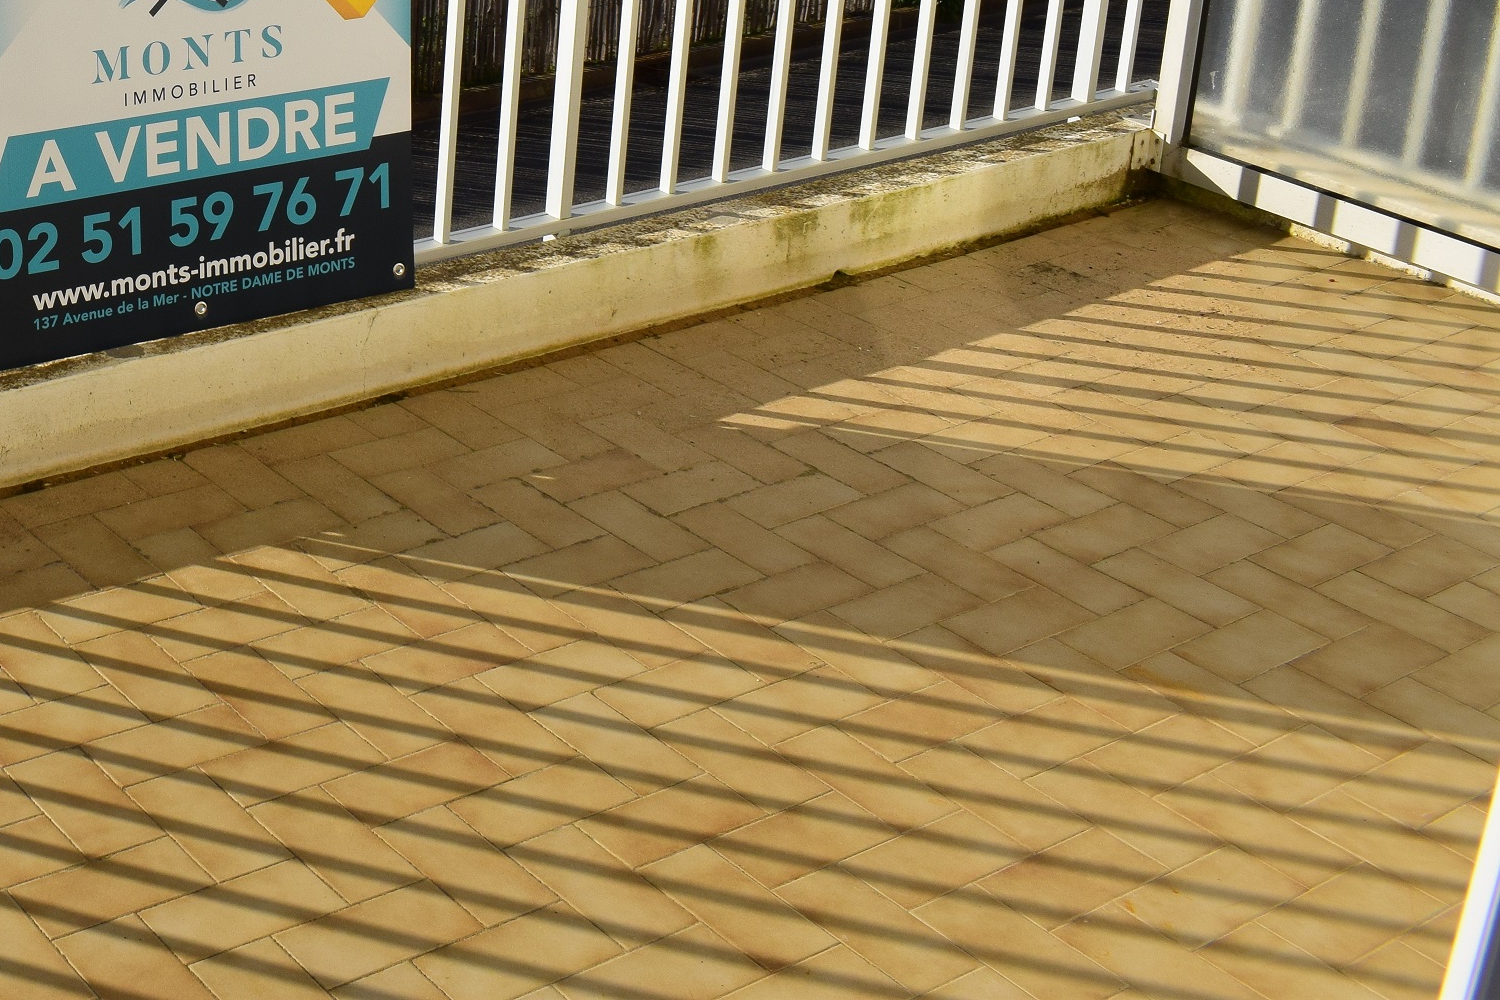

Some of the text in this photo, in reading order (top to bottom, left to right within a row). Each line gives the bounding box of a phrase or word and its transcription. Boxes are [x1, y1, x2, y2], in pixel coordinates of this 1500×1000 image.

[91, 24, 283, 85] MONTS
[123, 73, 258, 107] IMMOBILIER
[25, 91, 357, 199] A VENDRE
[80, 206, 143, 264] 51
[168, 190, 235, 248] 59
[252, 176, 318, 233] 76
[334, 162, 391, 218] 71
[32, 227, 356, 311] www.monts-immobilier.fr
[33, 314, 60, 331] 137
[62, 306, 113, 326] Avenue
[116, 300, 135, 315] de
[137, 297, 150, 311] la
[152, 291, 180, 308] Mer
[190, 280, 238, 300] NOTRE
[241, 272, 283, 290] DAME
[286, 267, 305, 282] DE
[307, 256, 356, 278] MONTS
